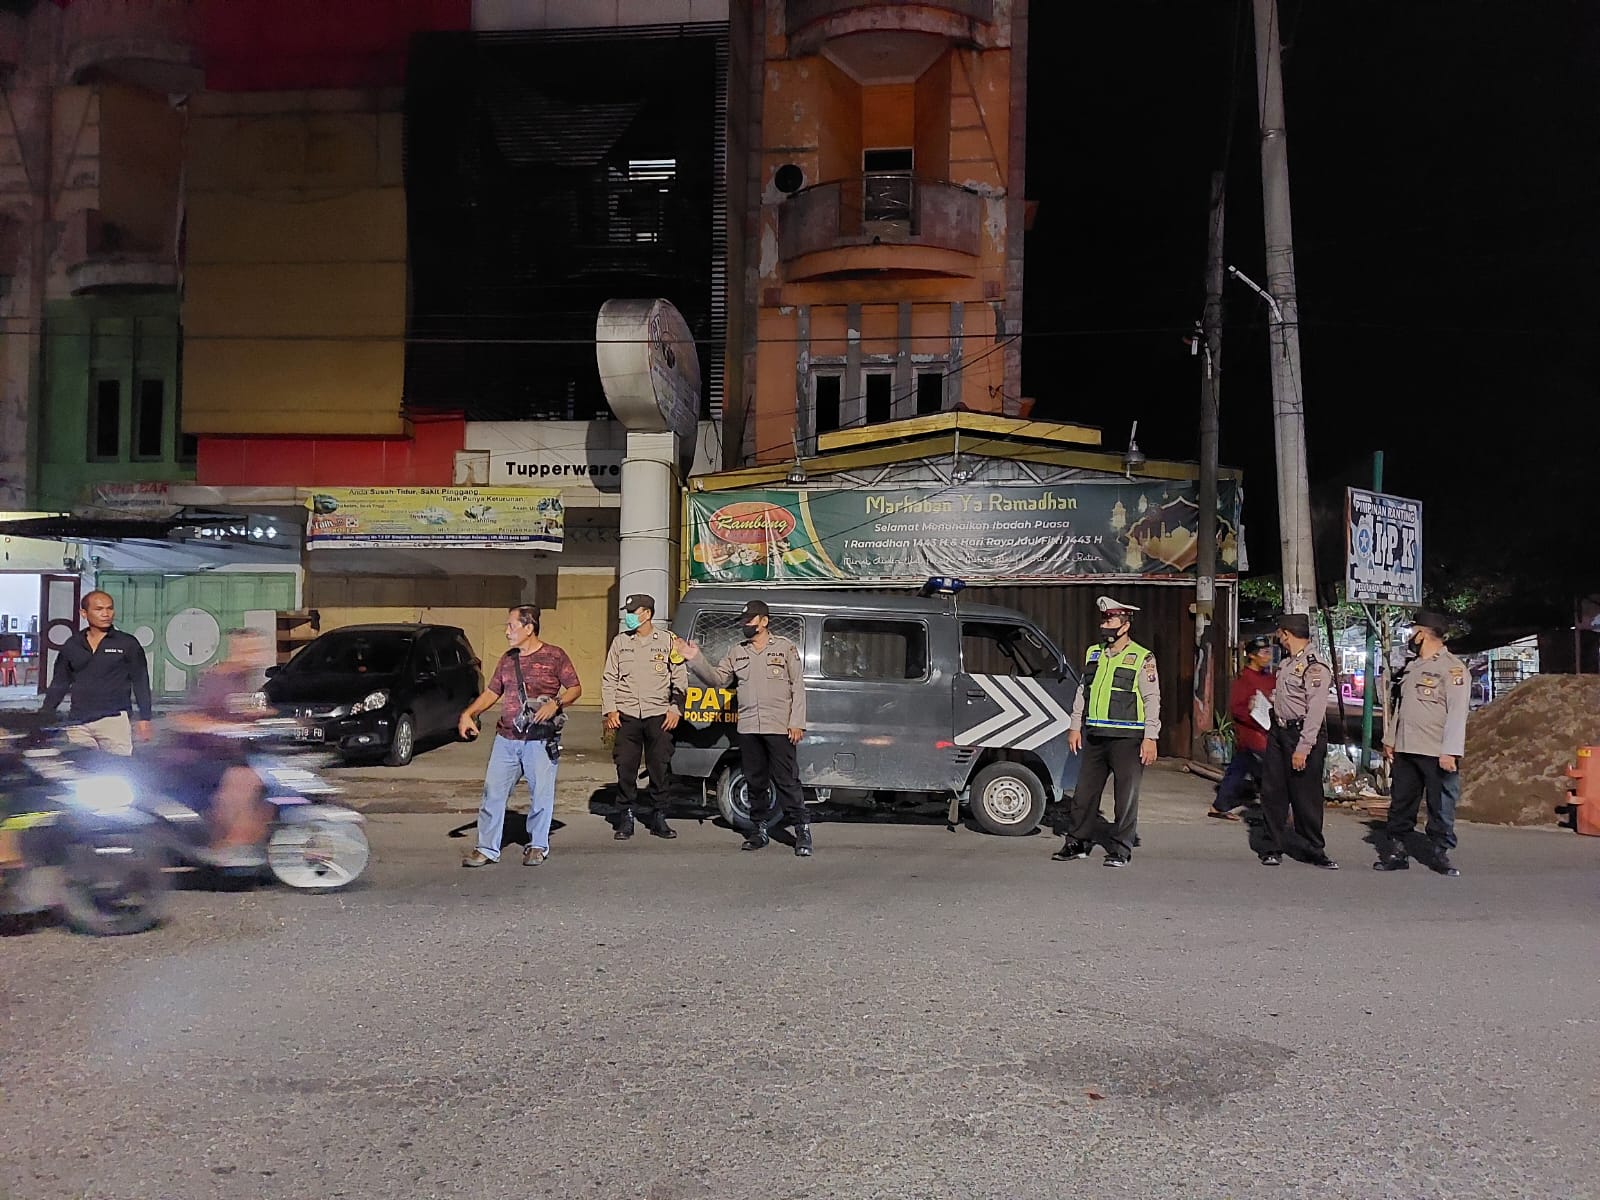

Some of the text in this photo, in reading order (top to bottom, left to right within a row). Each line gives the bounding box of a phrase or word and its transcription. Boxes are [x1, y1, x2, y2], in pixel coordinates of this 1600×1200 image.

[505, 461, 620, 478] Tupperware
[462, 496, 485, 504] Punya
[865, 491, 1078, 515] Marhaban Ya Ramadhan
[1355, 500, 1416, 523] PIMPINAN RANTING
[874, 522, 920, 533] Selamat
[992, 520, 1032, 531] Ibadah
[1034, 519, 1070, 529] Puasa
[850, 538, 910, 549] Ramadhan
[960, 537, 984, 547] Hari
[986, 537, 1014, 549] Raya
[1093, 535, 1104, 545] H
[1374, 521, 1416, 570] IPK
[684, 711, 722, 723] POLSEK
